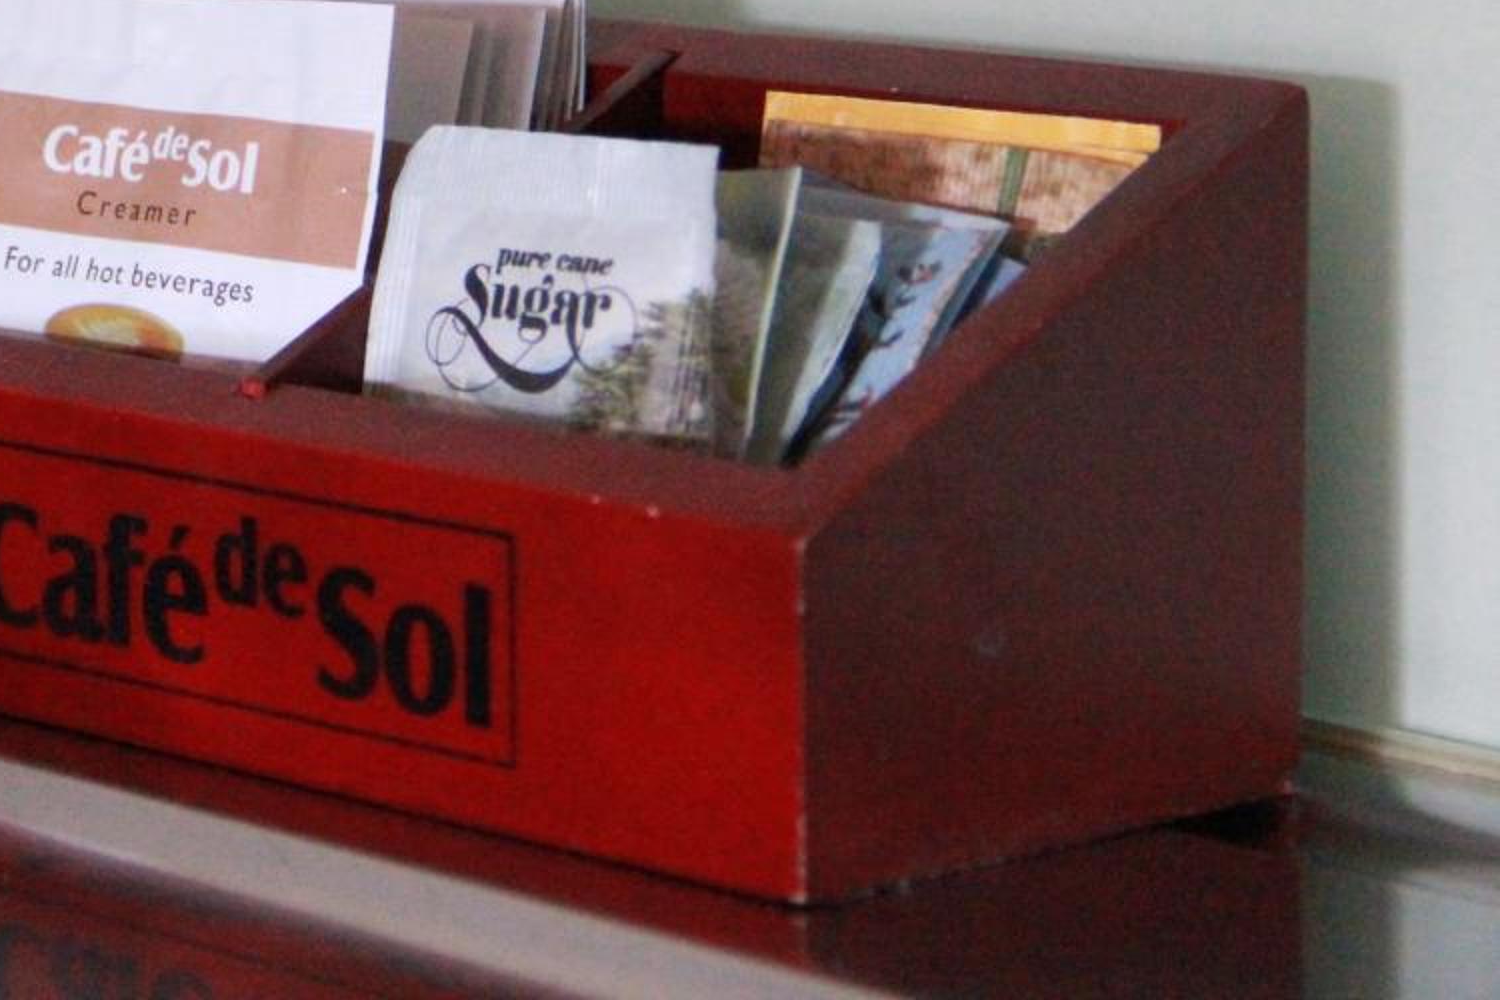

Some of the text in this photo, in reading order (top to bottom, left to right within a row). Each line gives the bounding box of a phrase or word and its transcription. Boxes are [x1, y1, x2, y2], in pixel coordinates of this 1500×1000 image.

[43, 125, 259, 194] Café de Sol
[76, 190, 197, 226] Creamer
[4, 246, 255, 307] For all hot beverages
[496, 248, 614, 275] pure cane
[437, 263, 614, 393] Sugar
[214, 516, 308, 620] de
[315, 567, 492, 728] Sol
